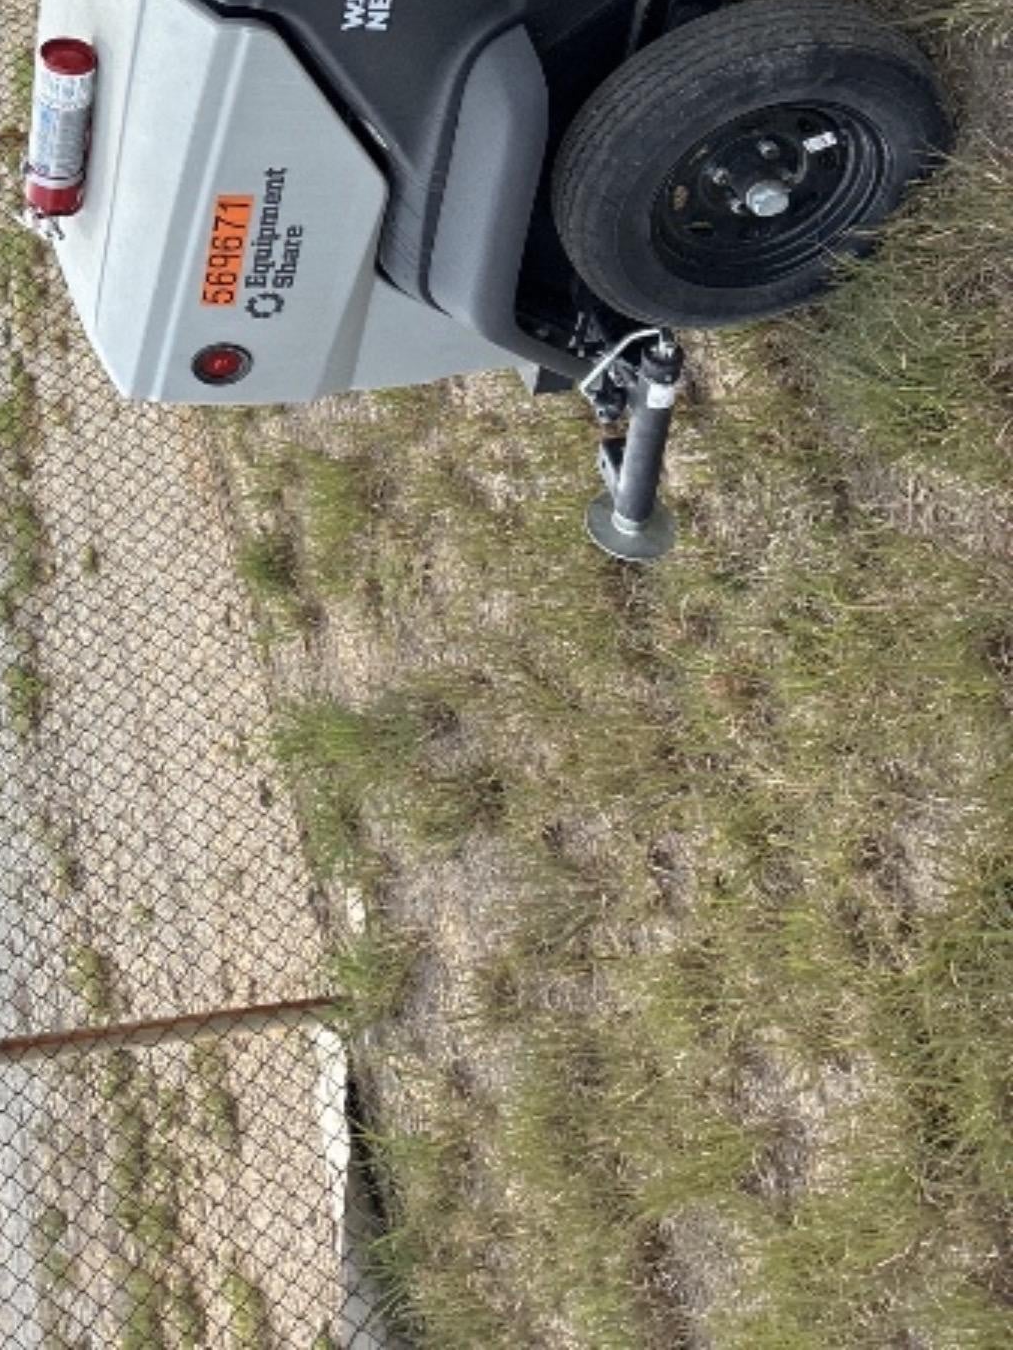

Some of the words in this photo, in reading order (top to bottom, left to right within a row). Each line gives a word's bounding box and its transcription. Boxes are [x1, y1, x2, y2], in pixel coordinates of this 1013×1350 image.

[203, 201, 249, 305] 569671
[244, 167, 287, 289] Equipment
[272, 224, 302, 288] Share
